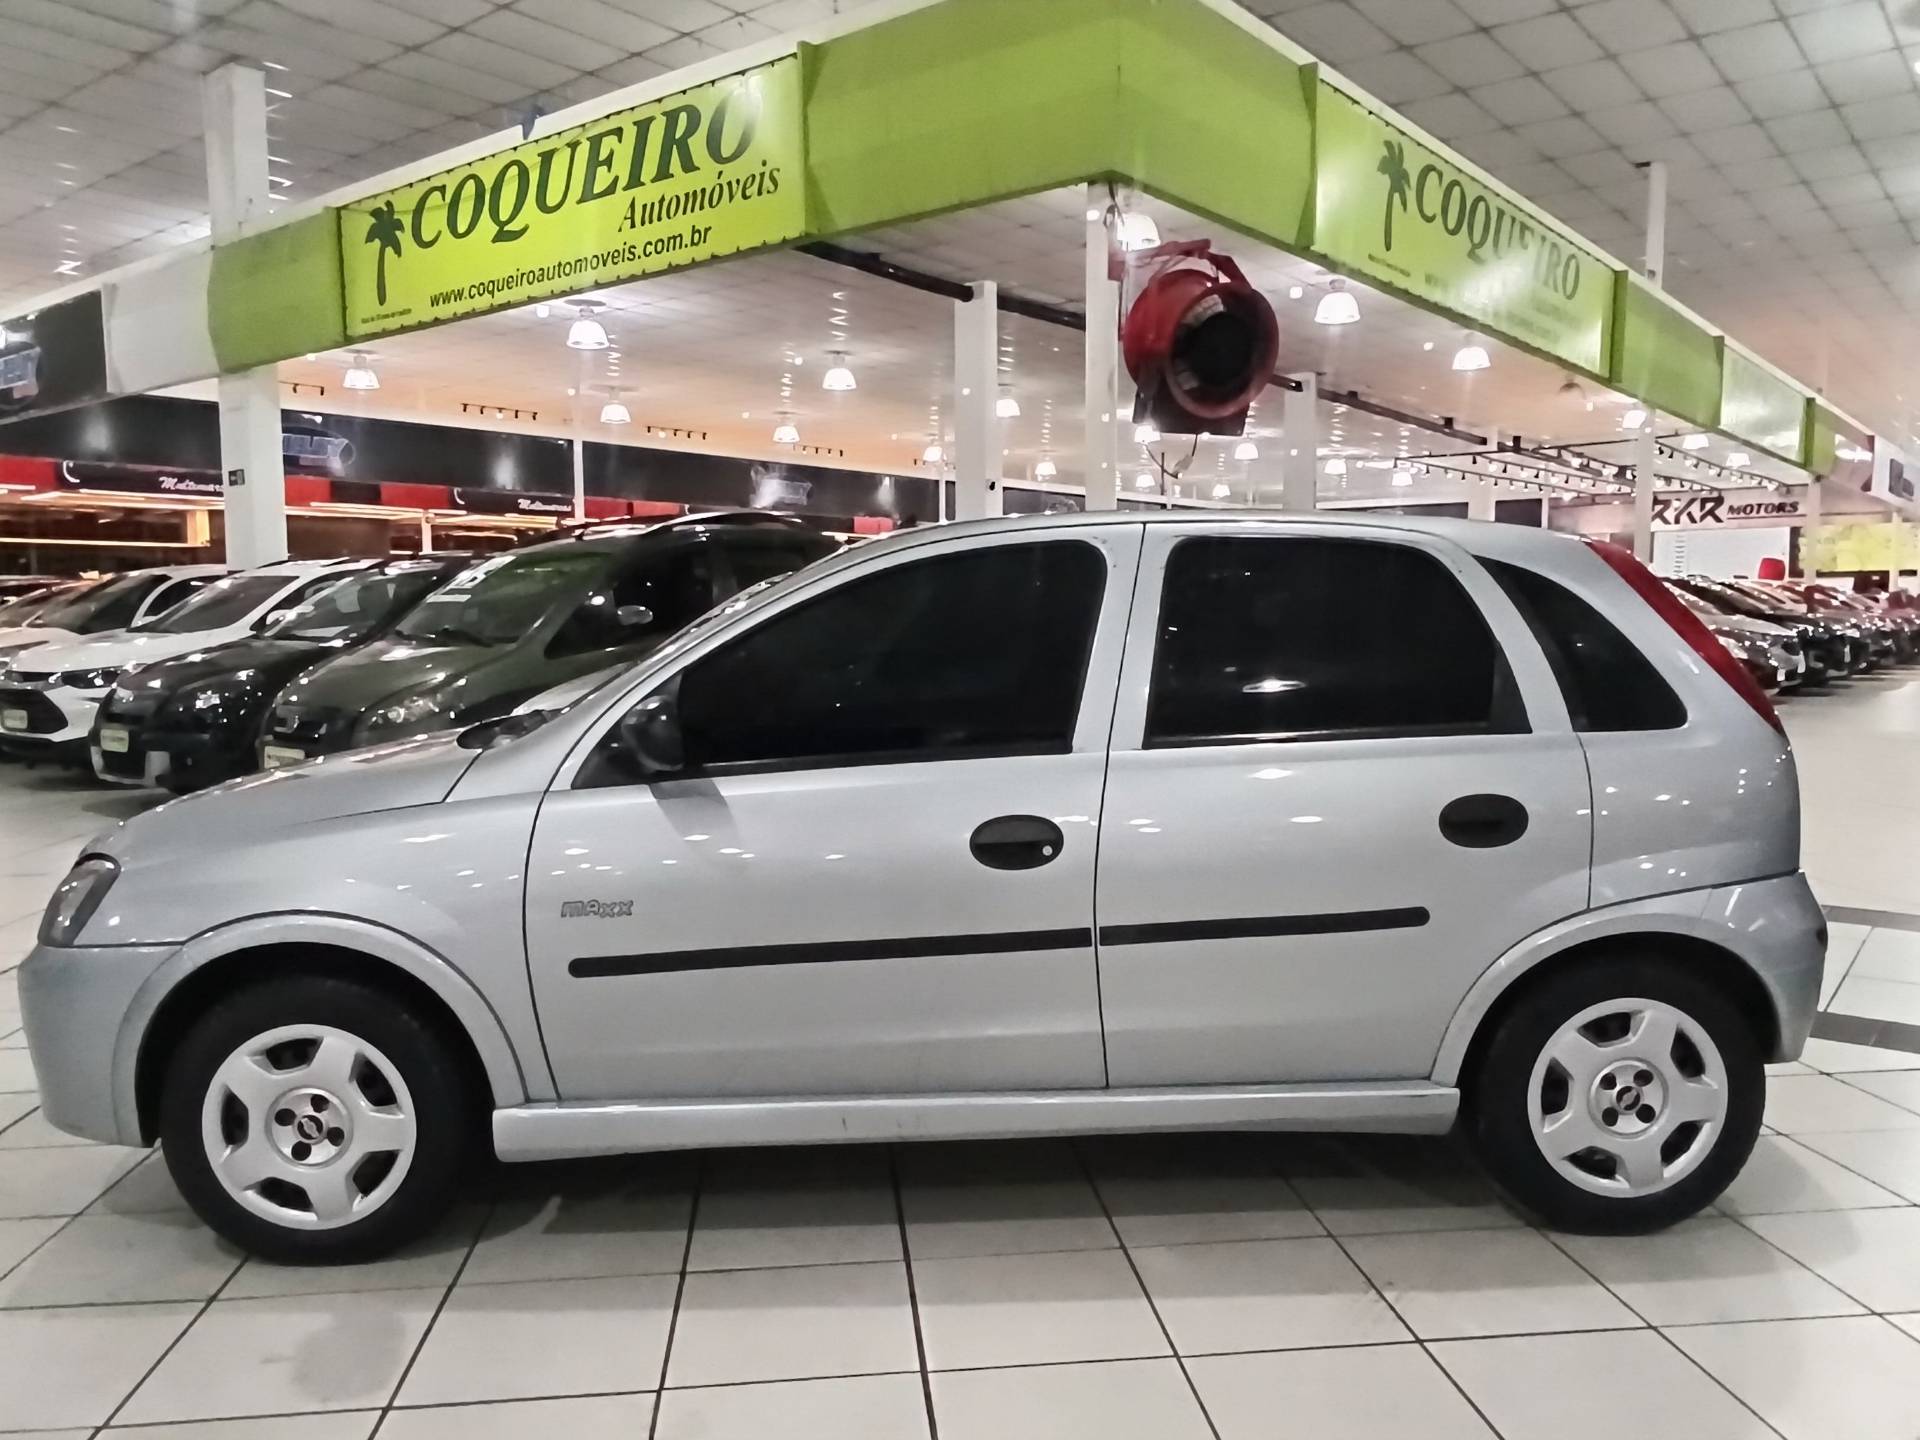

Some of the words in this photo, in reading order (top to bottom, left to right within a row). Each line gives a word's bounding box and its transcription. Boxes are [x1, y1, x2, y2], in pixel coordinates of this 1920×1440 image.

[411, 88, 763, 249] COQUEIRO
[618, 159, 780, 232] Automóveis
[430, 223, 712, 308] www.coqueiroautomoveis.com.br
[1415, 163, 1581, 301] COQUEIRO
[1726, 501, 1800, 515] MOTORS
